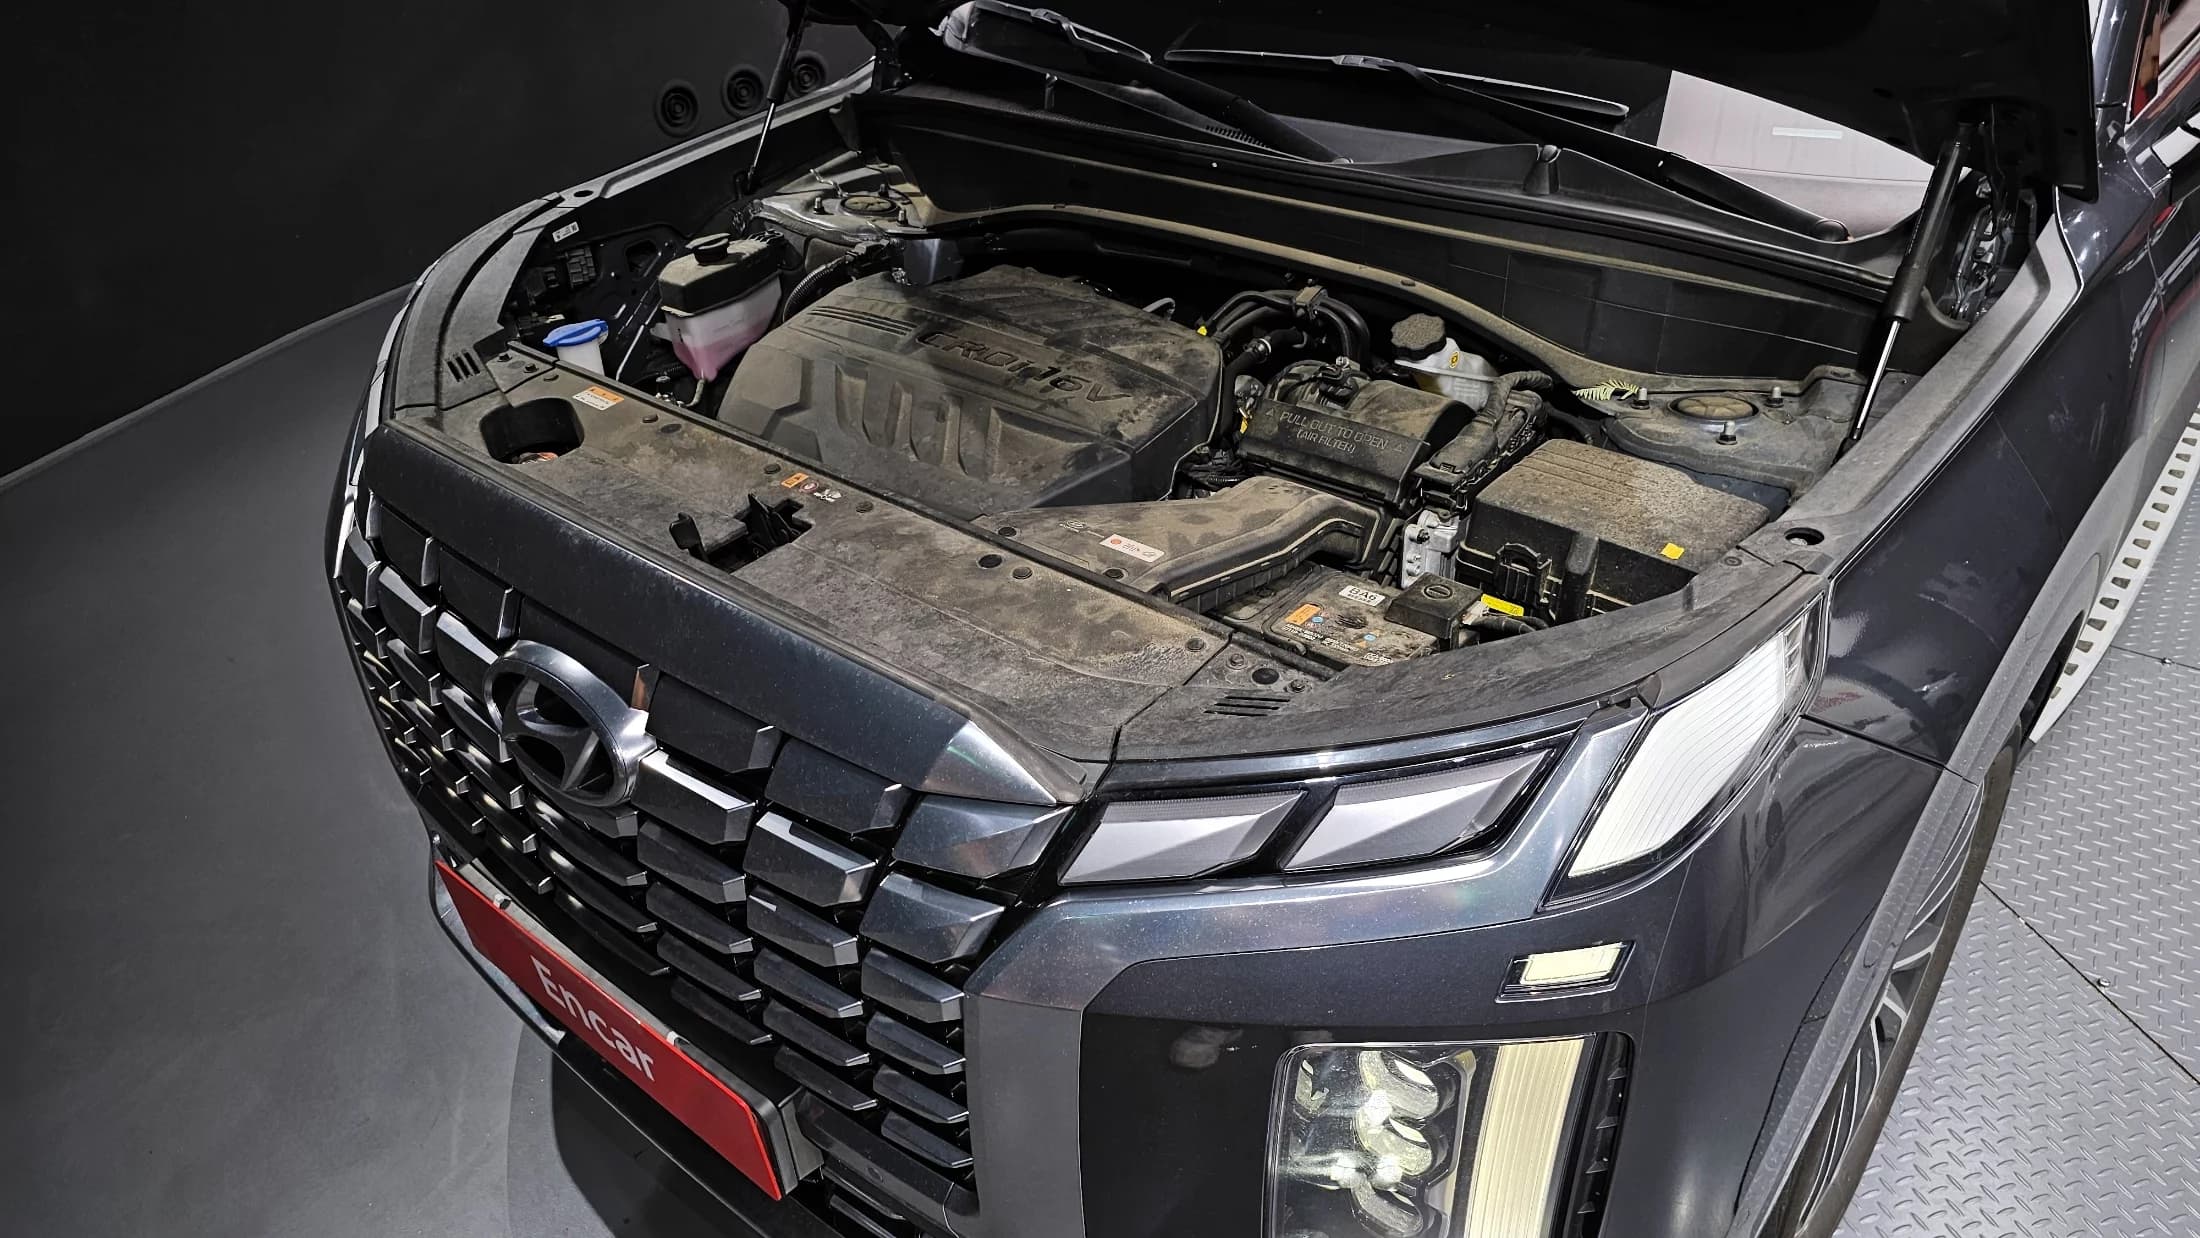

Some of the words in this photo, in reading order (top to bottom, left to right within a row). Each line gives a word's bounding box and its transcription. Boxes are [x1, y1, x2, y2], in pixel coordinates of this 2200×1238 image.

[1280, 411, 1307, 427] PULL
[1310, 419, 1336, 434] OUT
[1337, 426, 1353, 439] TO
[1354, 432, 1389, 450] OPEN
[1296, 429, 1318, 443] (AIR
[1318, 435, 1356, 454] FILTER)
[530, 955, 656, 1082] Encar
